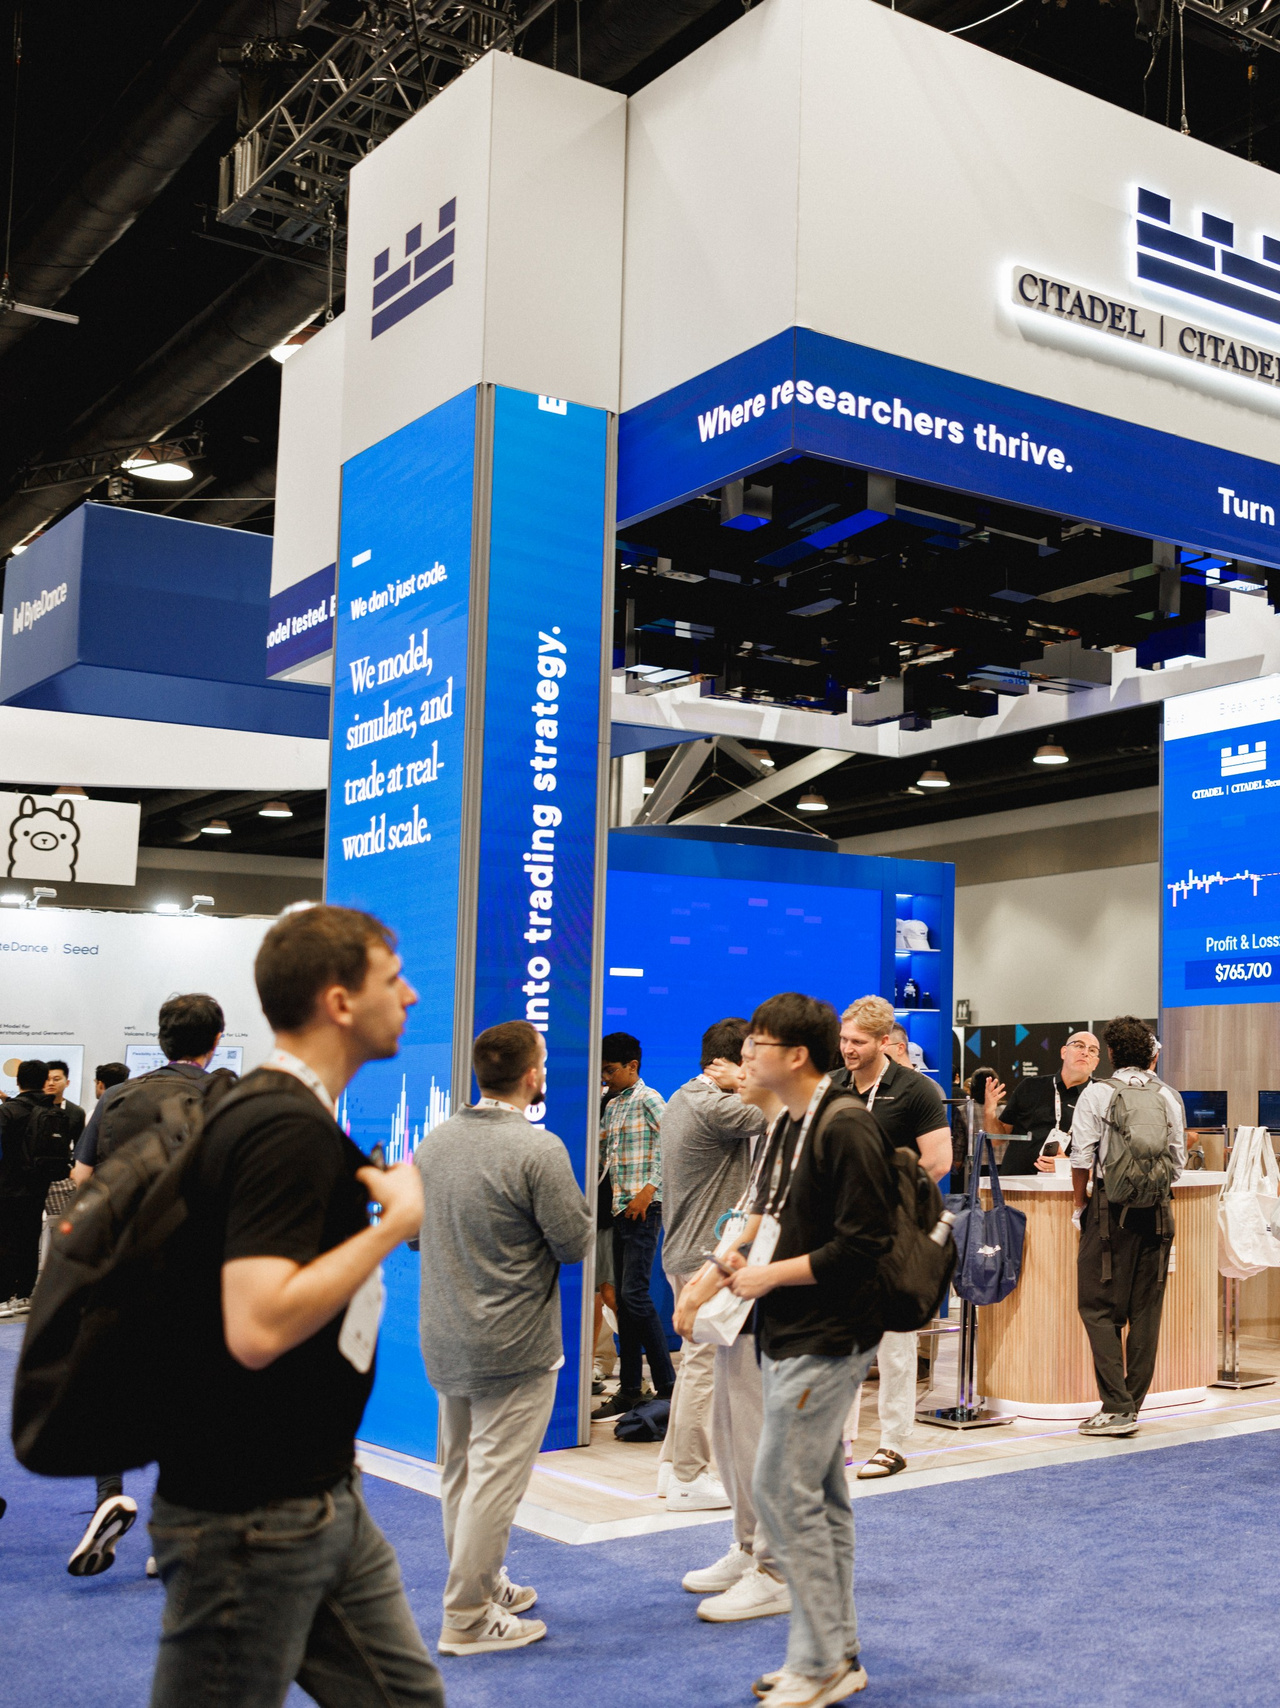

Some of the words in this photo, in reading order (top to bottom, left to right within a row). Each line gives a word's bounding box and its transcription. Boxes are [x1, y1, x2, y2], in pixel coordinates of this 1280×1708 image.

[1018, 273, 1145, 338] CITADEL
[698, 394, 766, 443] Where
[771, 380, 965, 444] researchers
[973, 424, 1073, 473] thrive.
[1218, 486, 1275, 526] Turn
[24, 582, 67, 630] ByteDance
[292, 599, 328, 636] tested.
[350, 598, 367, 621] We
[368, 582, 395, 612] don't
[394, 574, 416, 606] just
[417, 561, 447, 592] code.
[350, 656, 375, 696] We
[377, 628, 433, 686] model,
[346, 699, 417, 751] simulate,
[420, 676, 453, 726] and
[530, 625, 567, 792] strategy.
[344, 759, 385, 806] trade
[387, 762, 403, 794] at
[406, 740, 445, 790] real-
[1192, 786, 1225, 800] CITADEL
[1230, 779, 1265, 794] CITADEL
[342, 812, 386, 861] world
[388, 804, 432, 852] scale.
[522, 804, 562, 943] trading
[63, 943, 99, 955] Seed
[1205, 934, 1237, 953] Profit
[1240, 935, 1249, 950] &
[1214, 960, 1272, 983] $765,700
[522, 955, 551, 1032] into
